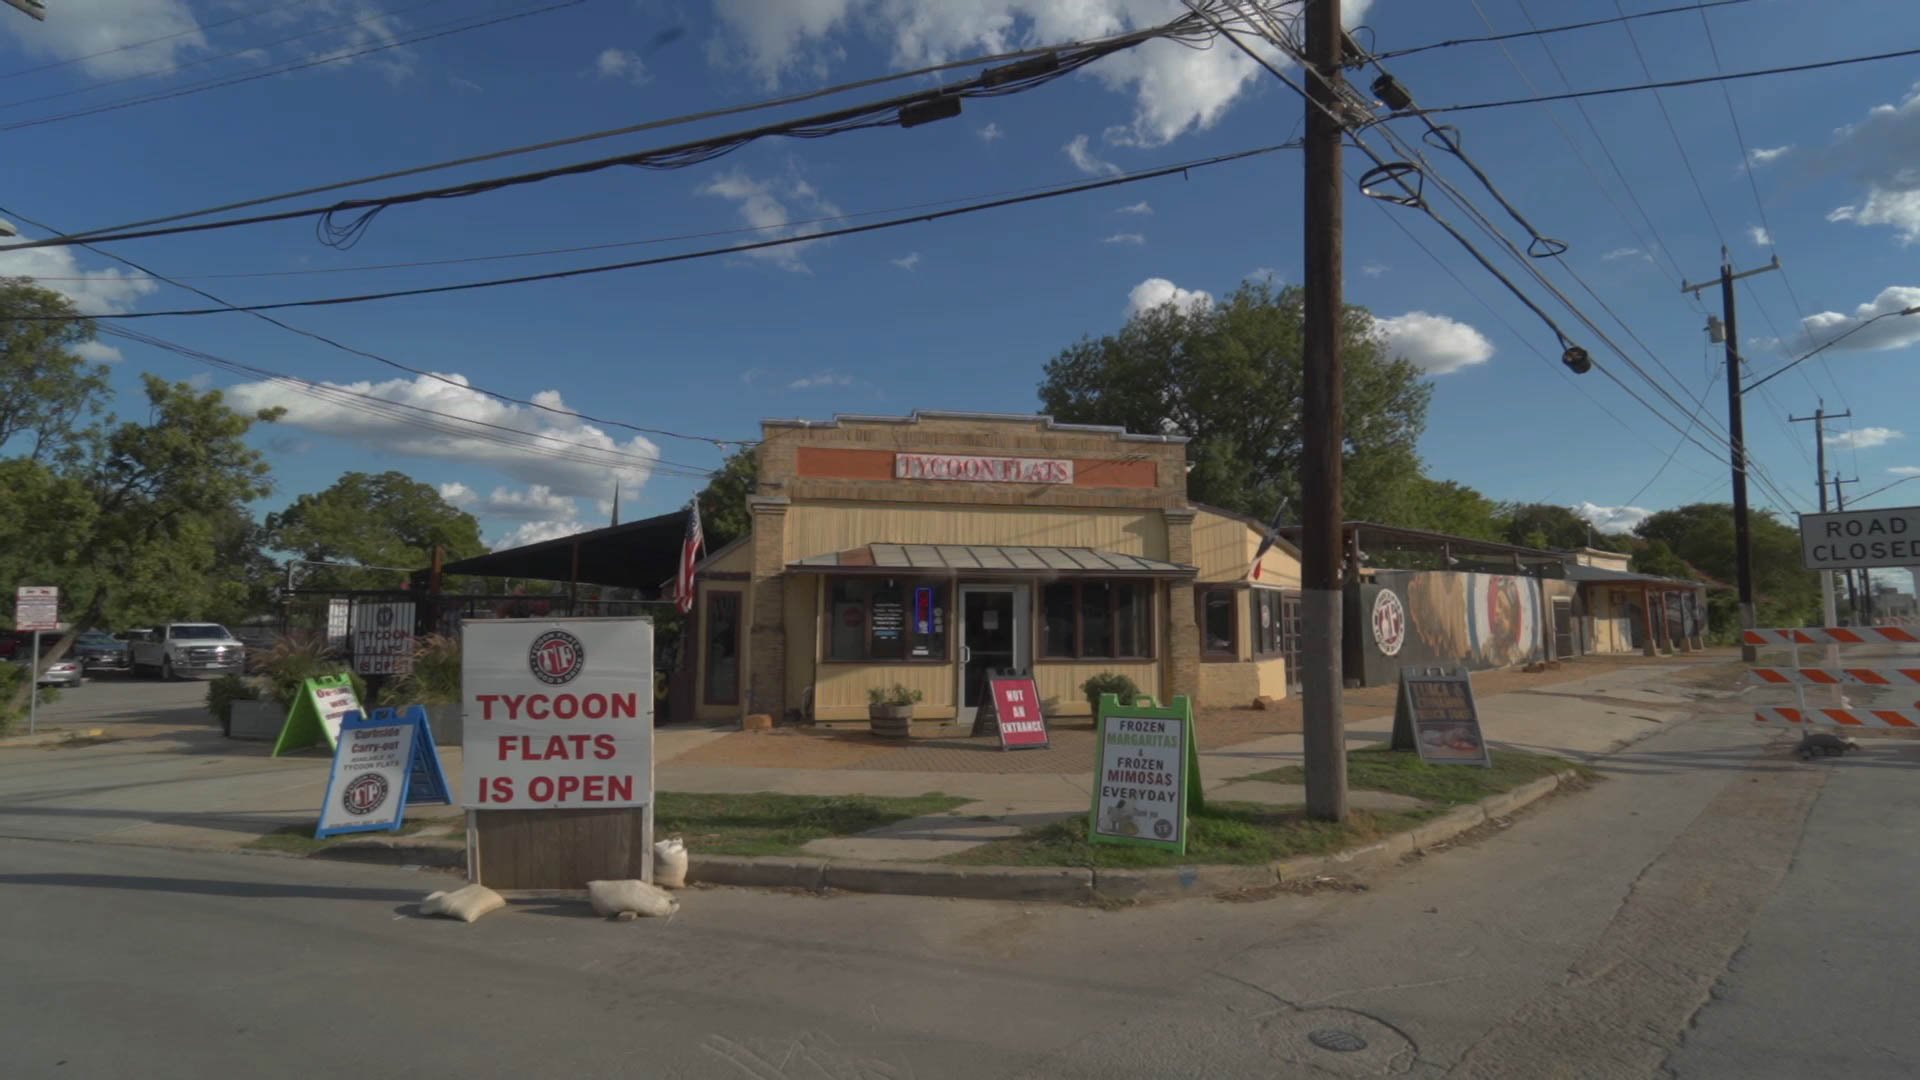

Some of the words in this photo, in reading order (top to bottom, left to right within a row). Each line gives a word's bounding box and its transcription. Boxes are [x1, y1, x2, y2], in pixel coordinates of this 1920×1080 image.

[901, 456, 995, 480] TYCOON
[1003, 459, 1067, 482] FLATS
[1826, 517, 1907, 537] ROAD
[1813, 541, 1920, 561] CLOSED
[1006, 690, 1024, 702] NOT
[476, 693, 636, 720] TYCOON
[1002, 721, 1043, 733] ENTRANCE
[1119, 720, 1165, 733] FROZEN
[498, 734, 616, 760] FLATS
[1107, 733, 1177, 748] MARGARITAS
[344, 763, 374, 771] TYCOON
[1117, 757, 1163, 770] FROZEN
[1107, 769, 1173, 787] MIMOSAS
[479, 777, 513, 803] IS
[528, 776, 632, 802] OPEN
[1102, 786, 1176, 802] EVERYDAY
